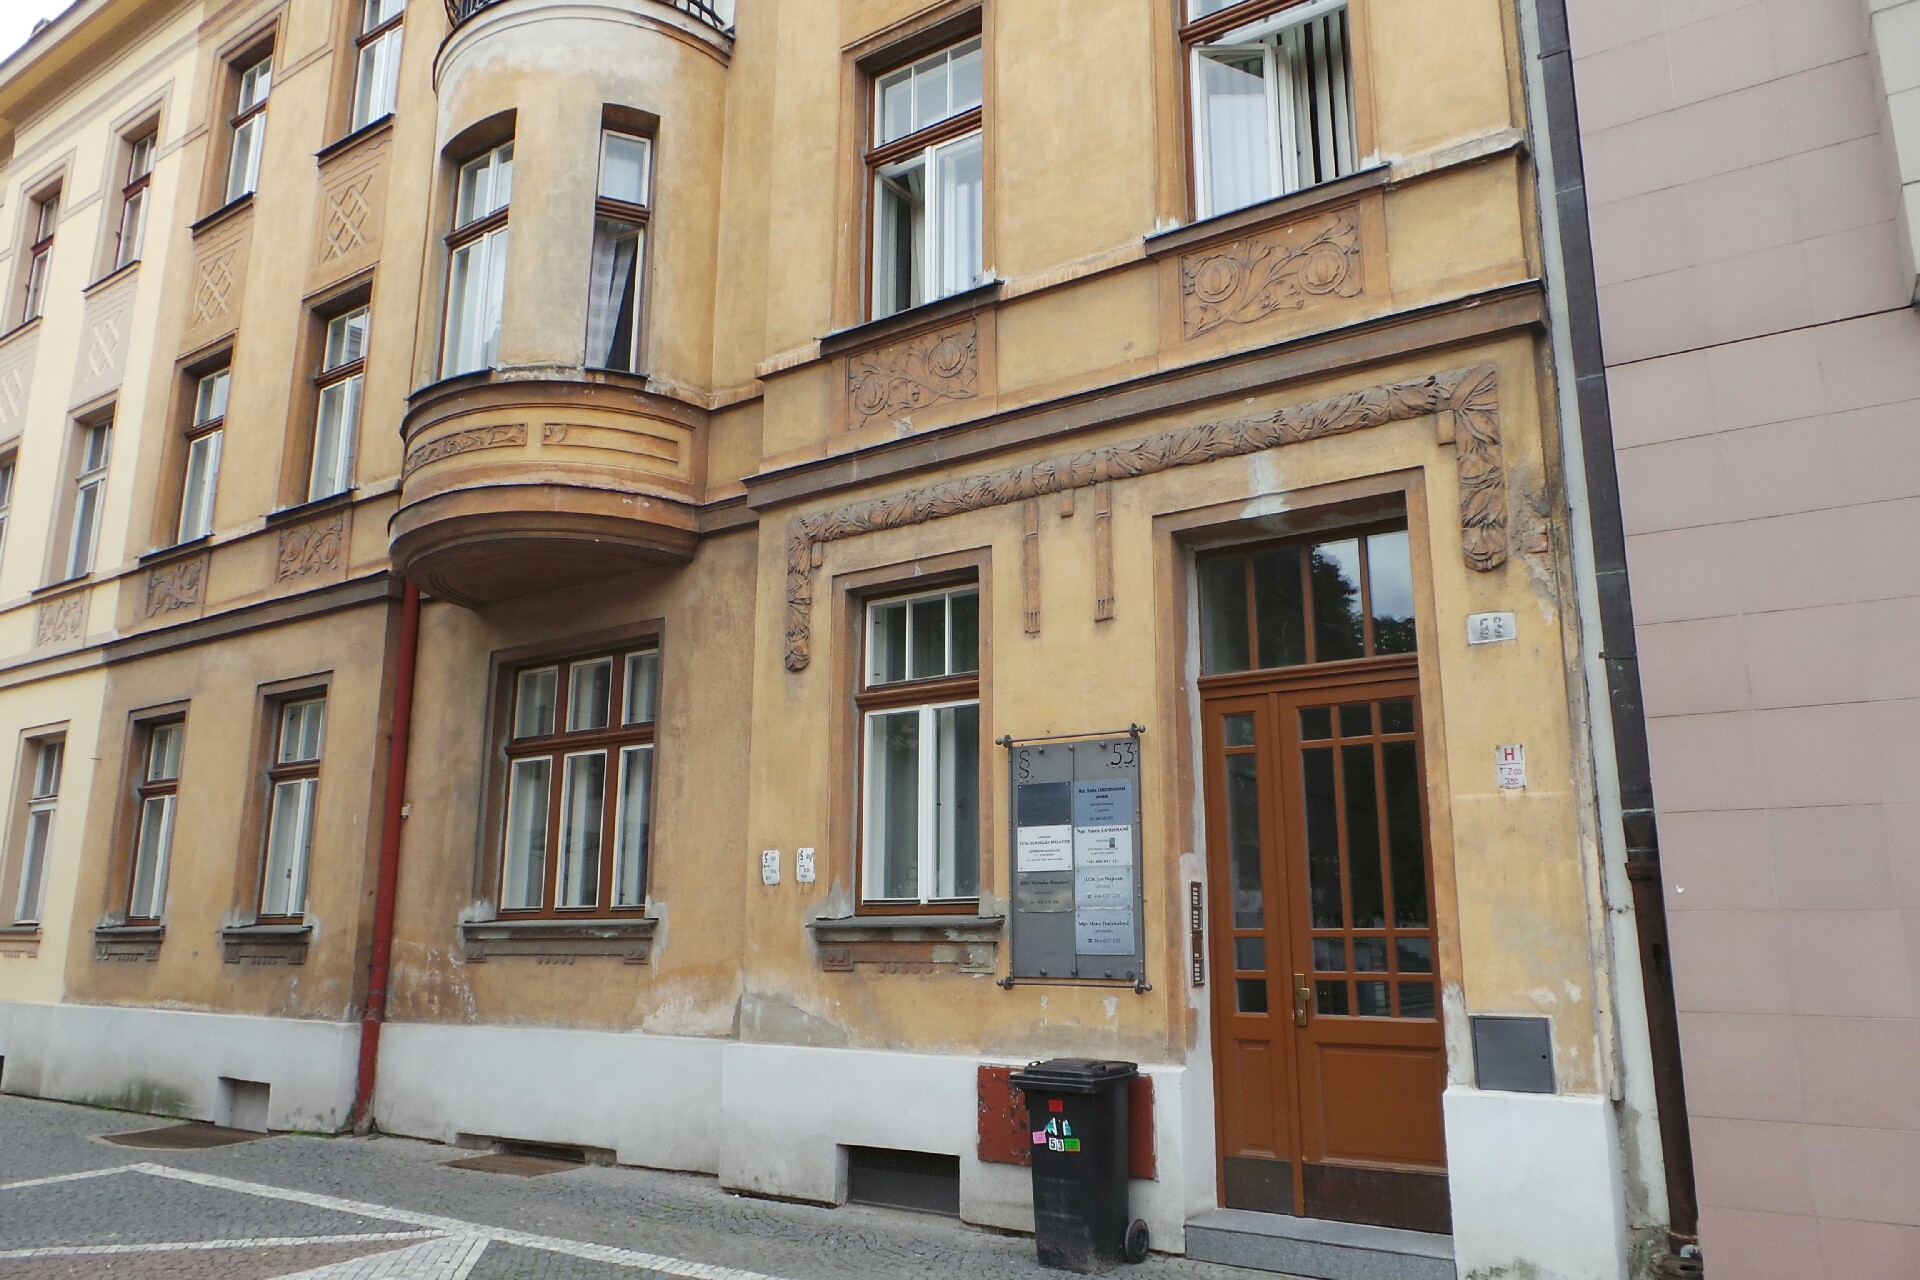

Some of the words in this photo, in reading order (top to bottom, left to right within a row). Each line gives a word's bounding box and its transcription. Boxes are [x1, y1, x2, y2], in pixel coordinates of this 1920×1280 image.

[1111, 742, 1135, 766] 53
[1504, 747, 1515, 761] H
[1050, 1138, 1064, 1150] 53
